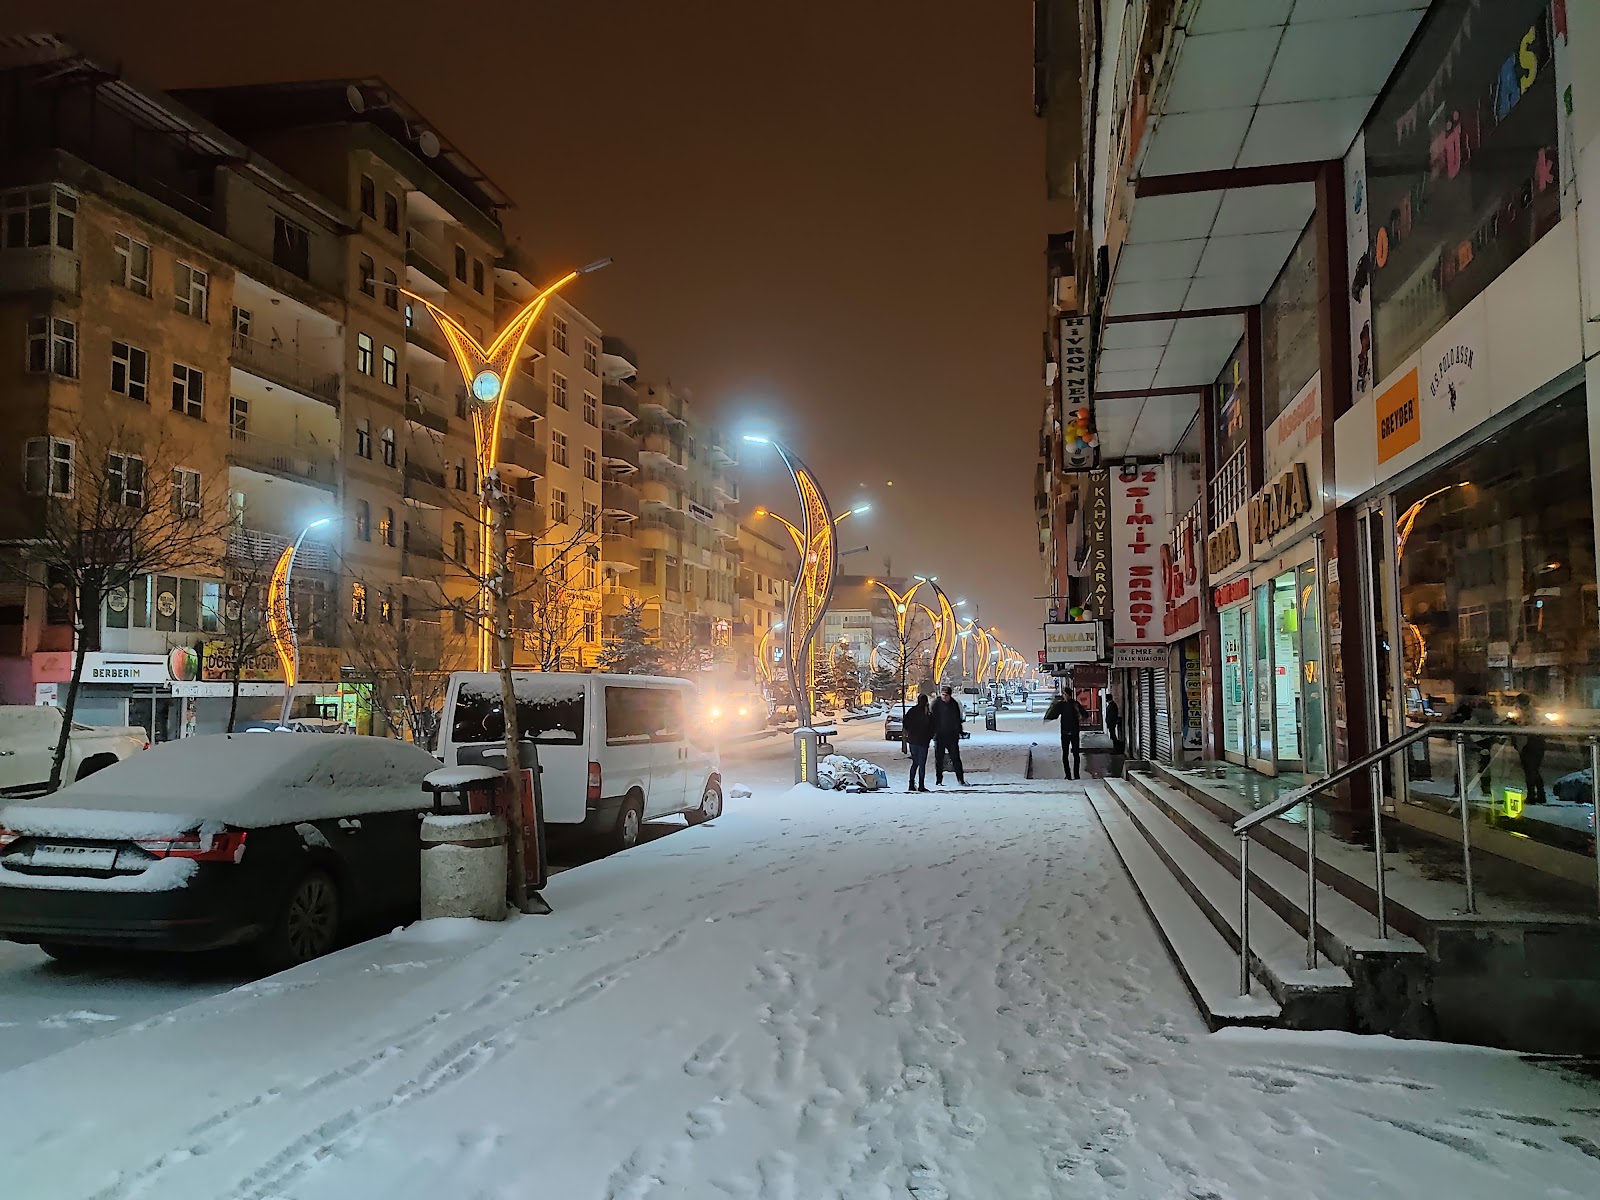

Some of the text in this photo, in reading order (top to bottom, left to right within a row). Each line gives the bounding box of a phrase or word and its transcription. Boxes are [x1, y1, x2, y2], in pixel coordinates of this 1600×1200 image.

[1381, 399, 1414, 440] GREYDER
[1094, 487, 1106, 541] KAHVE
[1248, 463, 1312, 544] PLAZA
[1095, 550, 1107, 616] SARAYI
